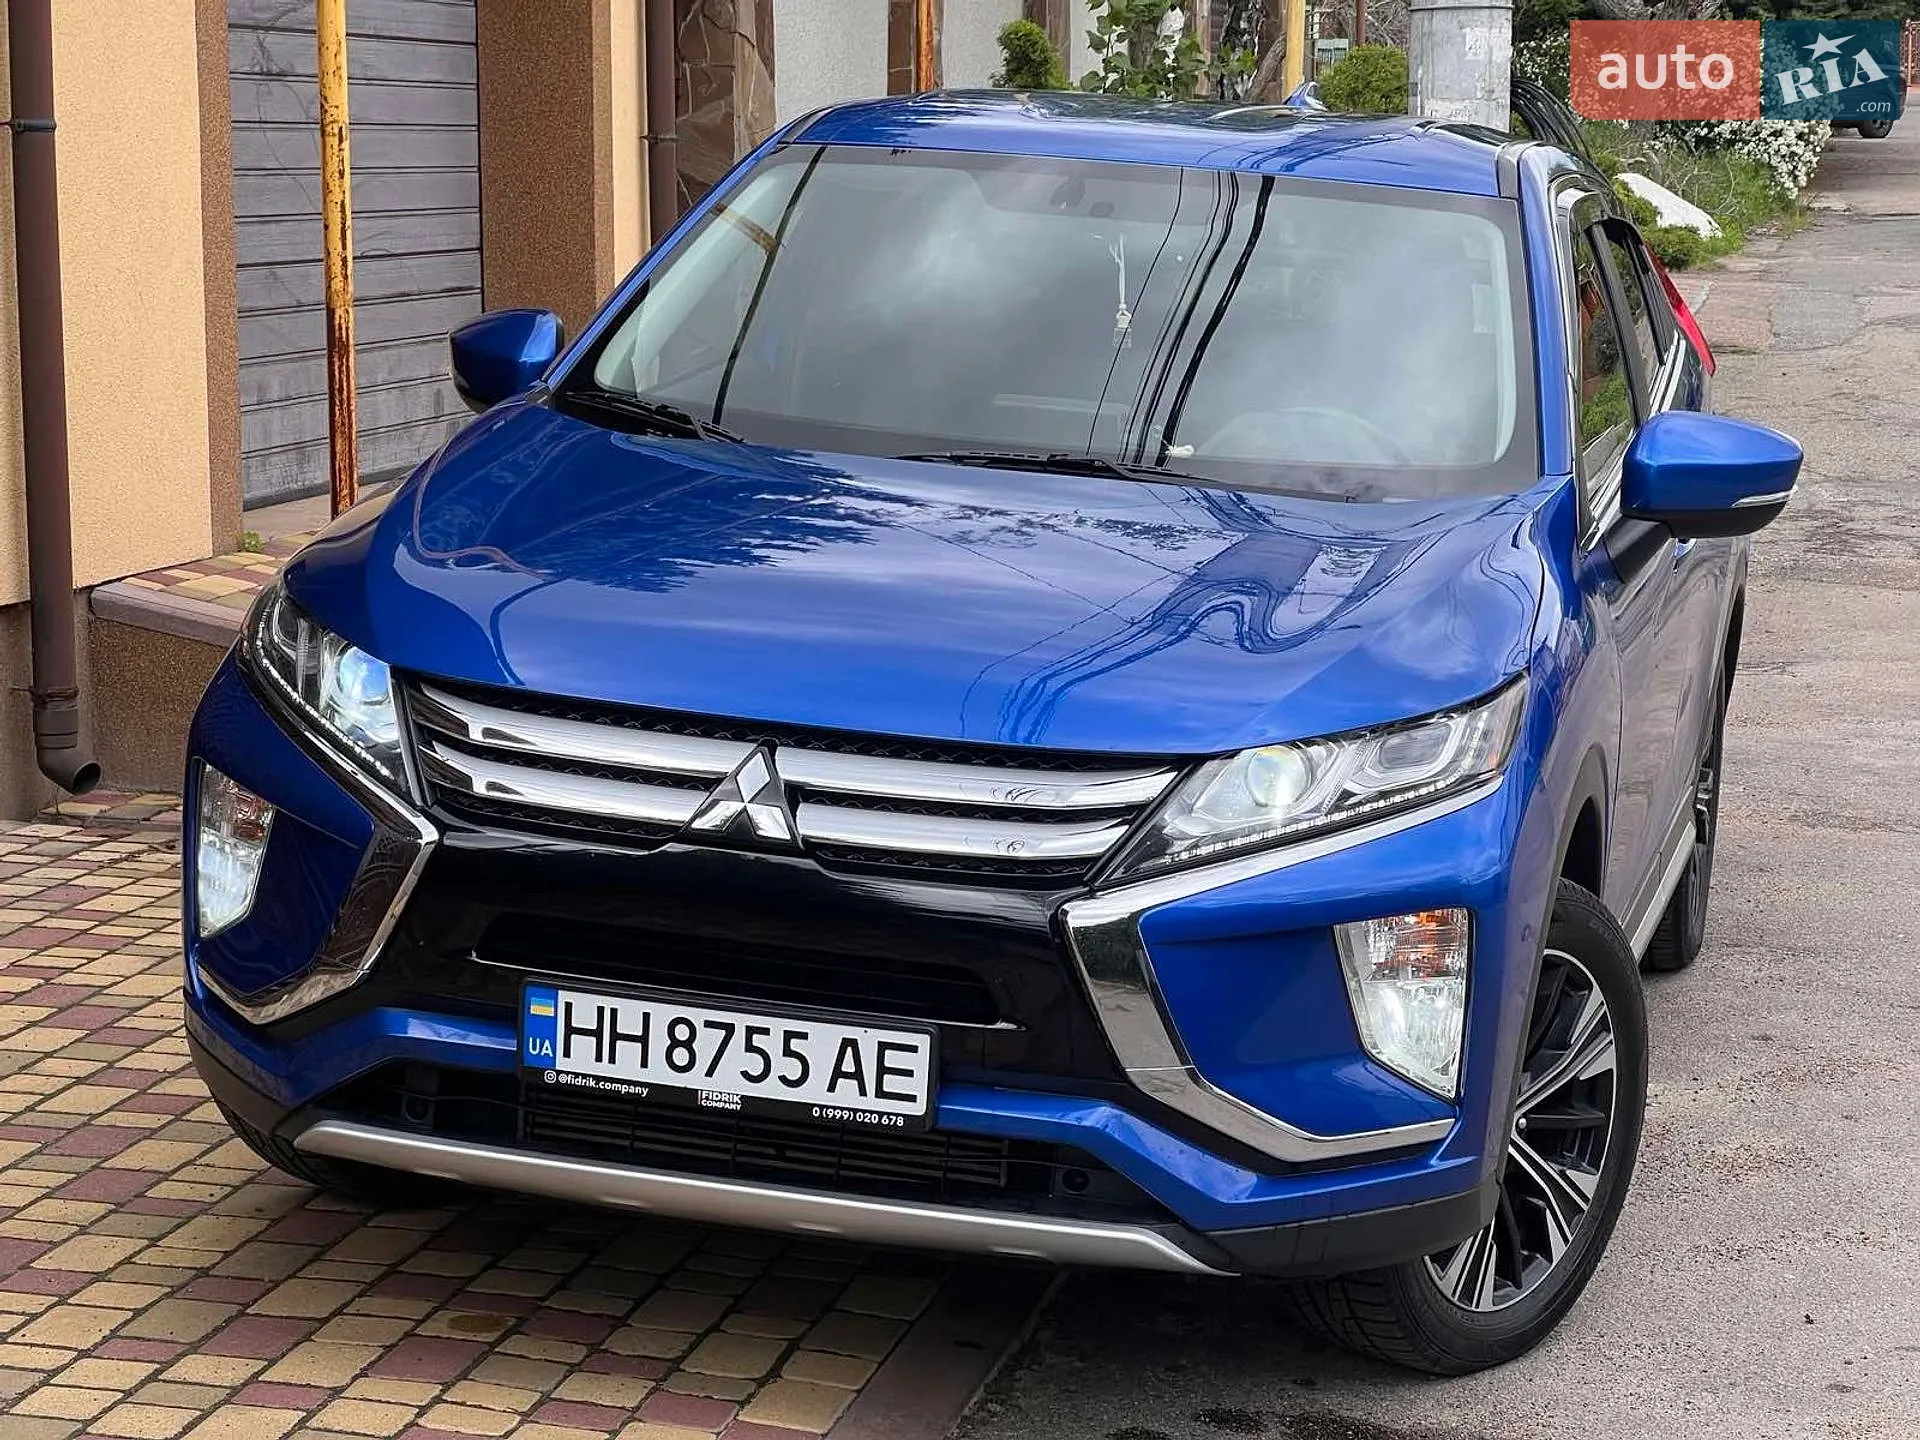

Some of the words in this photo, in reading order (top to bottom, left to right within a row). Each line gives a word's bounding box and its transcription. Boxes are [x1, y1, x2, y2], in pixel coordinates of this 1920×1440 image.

[528, 1036, 554, 1058] UA
[562, 1000, 651, 1070] HH
[664, 1016, 811, 1089] 8755
[826, 1036, 919, 1104] AE
[558, 1073, 650, 1098] @fidrik.company
[701, 1090, 742, 1104] FIDRIK
[701, 1099, 742, 1111] COMPANY
[812, 1107, 821, 1117] 0
[822, 1107, 854, 1121] (999)
[856, 1112, 879, 1124] 020
[881, 1116, 905, 1127] 678
